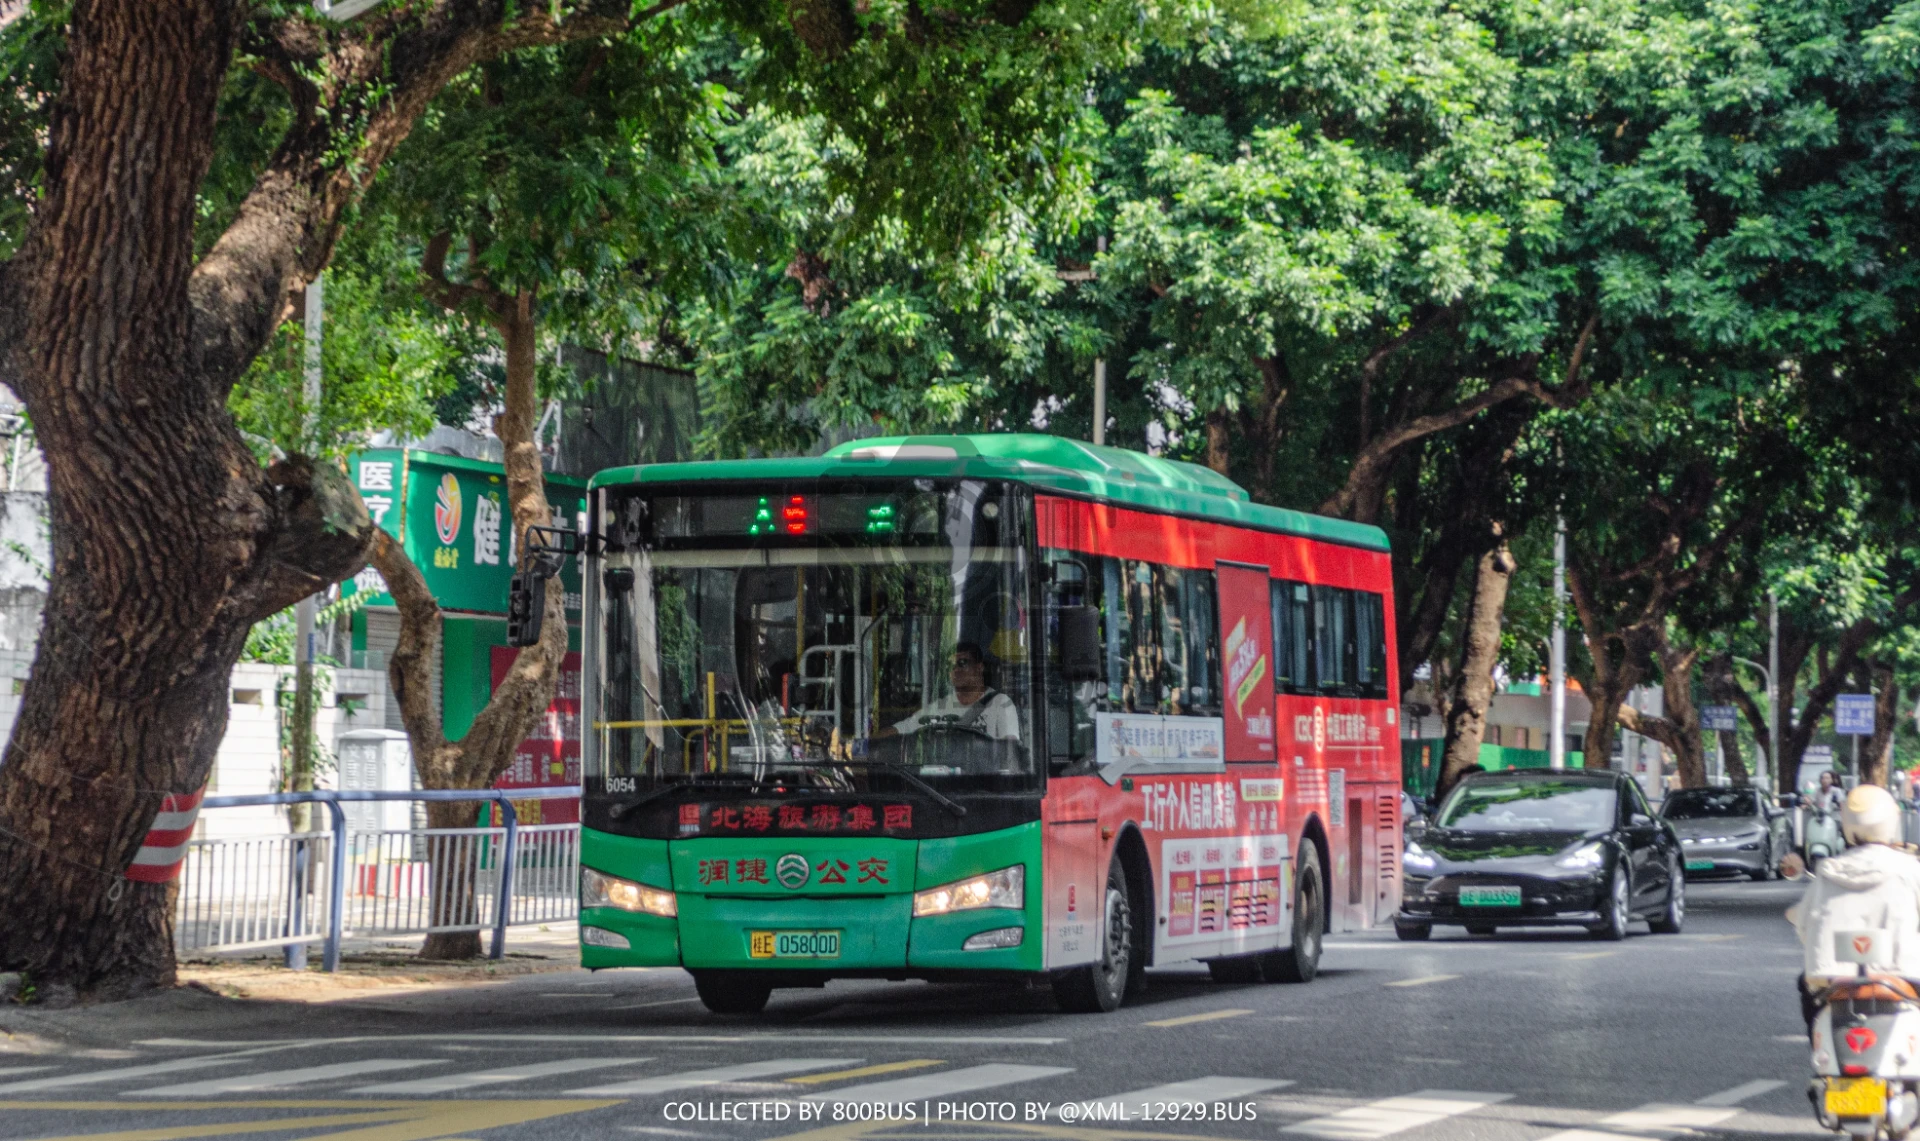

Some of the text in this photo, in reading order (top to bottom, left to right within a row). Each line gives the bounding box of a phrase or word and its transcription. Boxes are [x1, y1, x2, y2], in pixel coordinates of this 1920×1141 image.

[354, 461, 394, 593] 医疗械
[606, 778, 636, 793] 6054
[710, 804, 913, 831] 北海旅游集团
[1140, 781, 1237, 831] 工行个人信用贷款
[698, 858, 890, 886] 润捷 公交
[753, 935, 838, 954] 桂E 05800D
